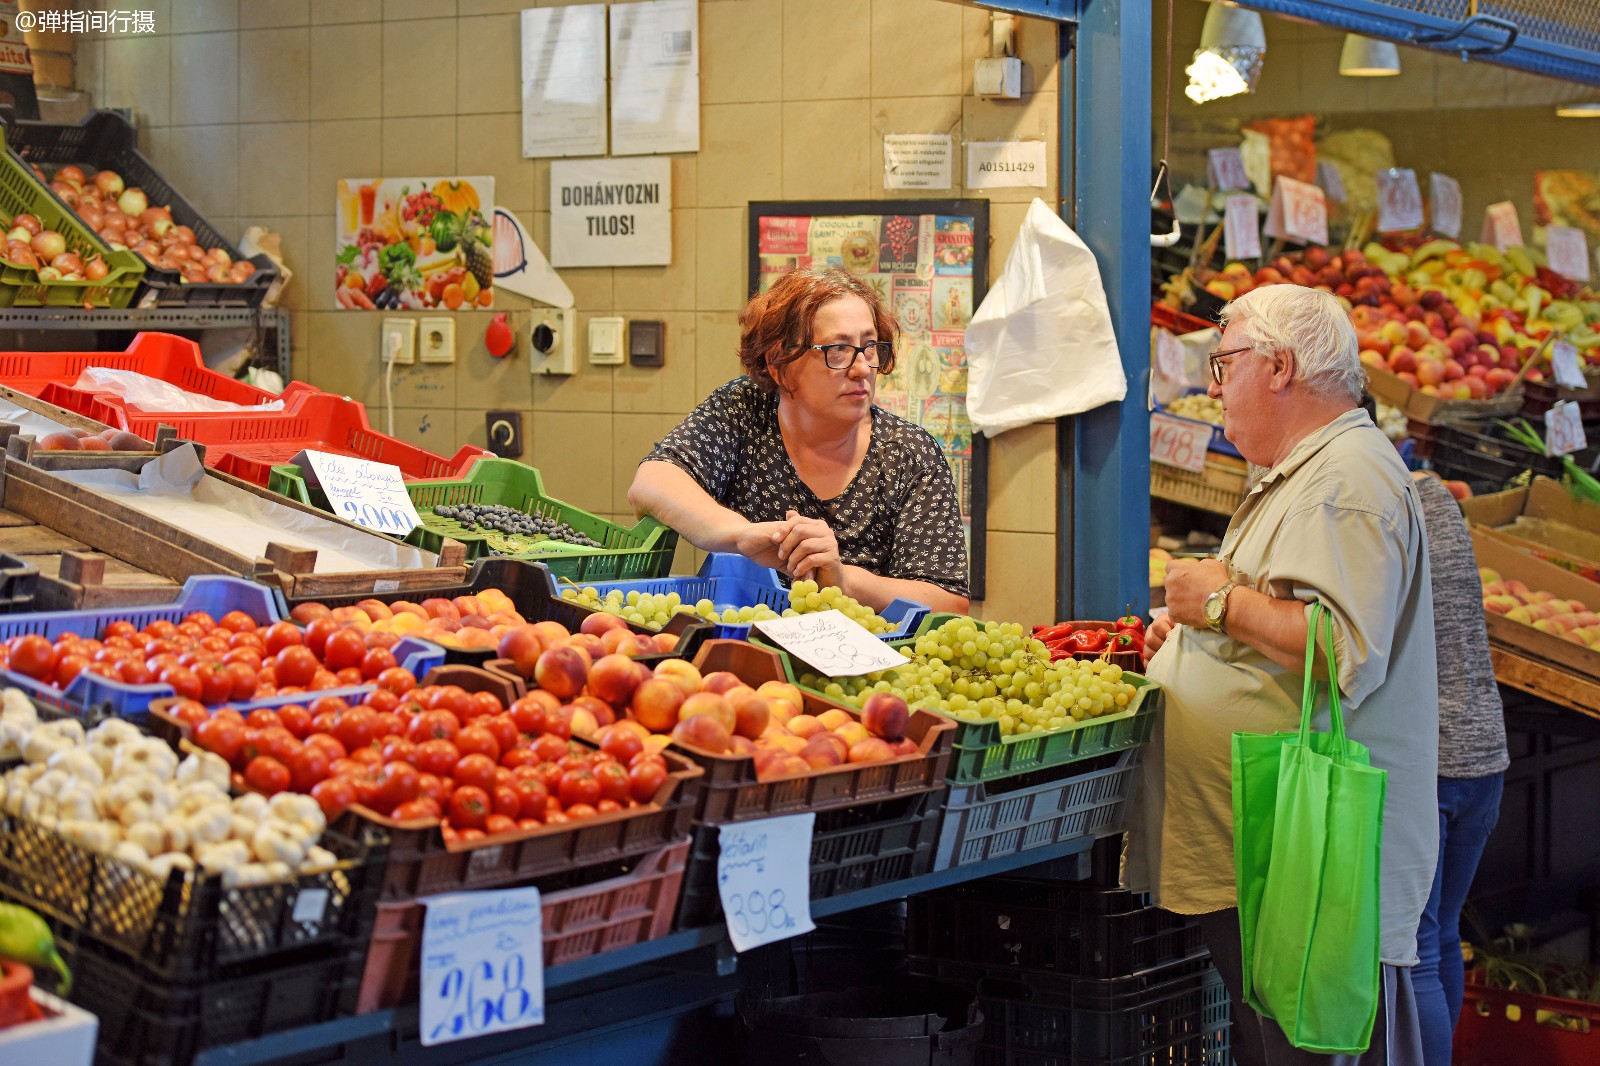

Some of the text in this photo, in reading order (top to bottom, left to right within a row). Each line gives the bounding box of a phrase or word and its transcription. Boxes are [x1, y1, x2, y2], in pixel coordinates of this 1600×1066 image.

[978, 161, 1035, 172] A01511429
[562, 181, 659, 206] DOHÁNYOZNI
[586, 214, 635, 236] TILOS!
[880, 261, 916, 270] VIN ROUGE
[729, 888, 787, 937] 398
[430, 953, 530, 1039] 268
